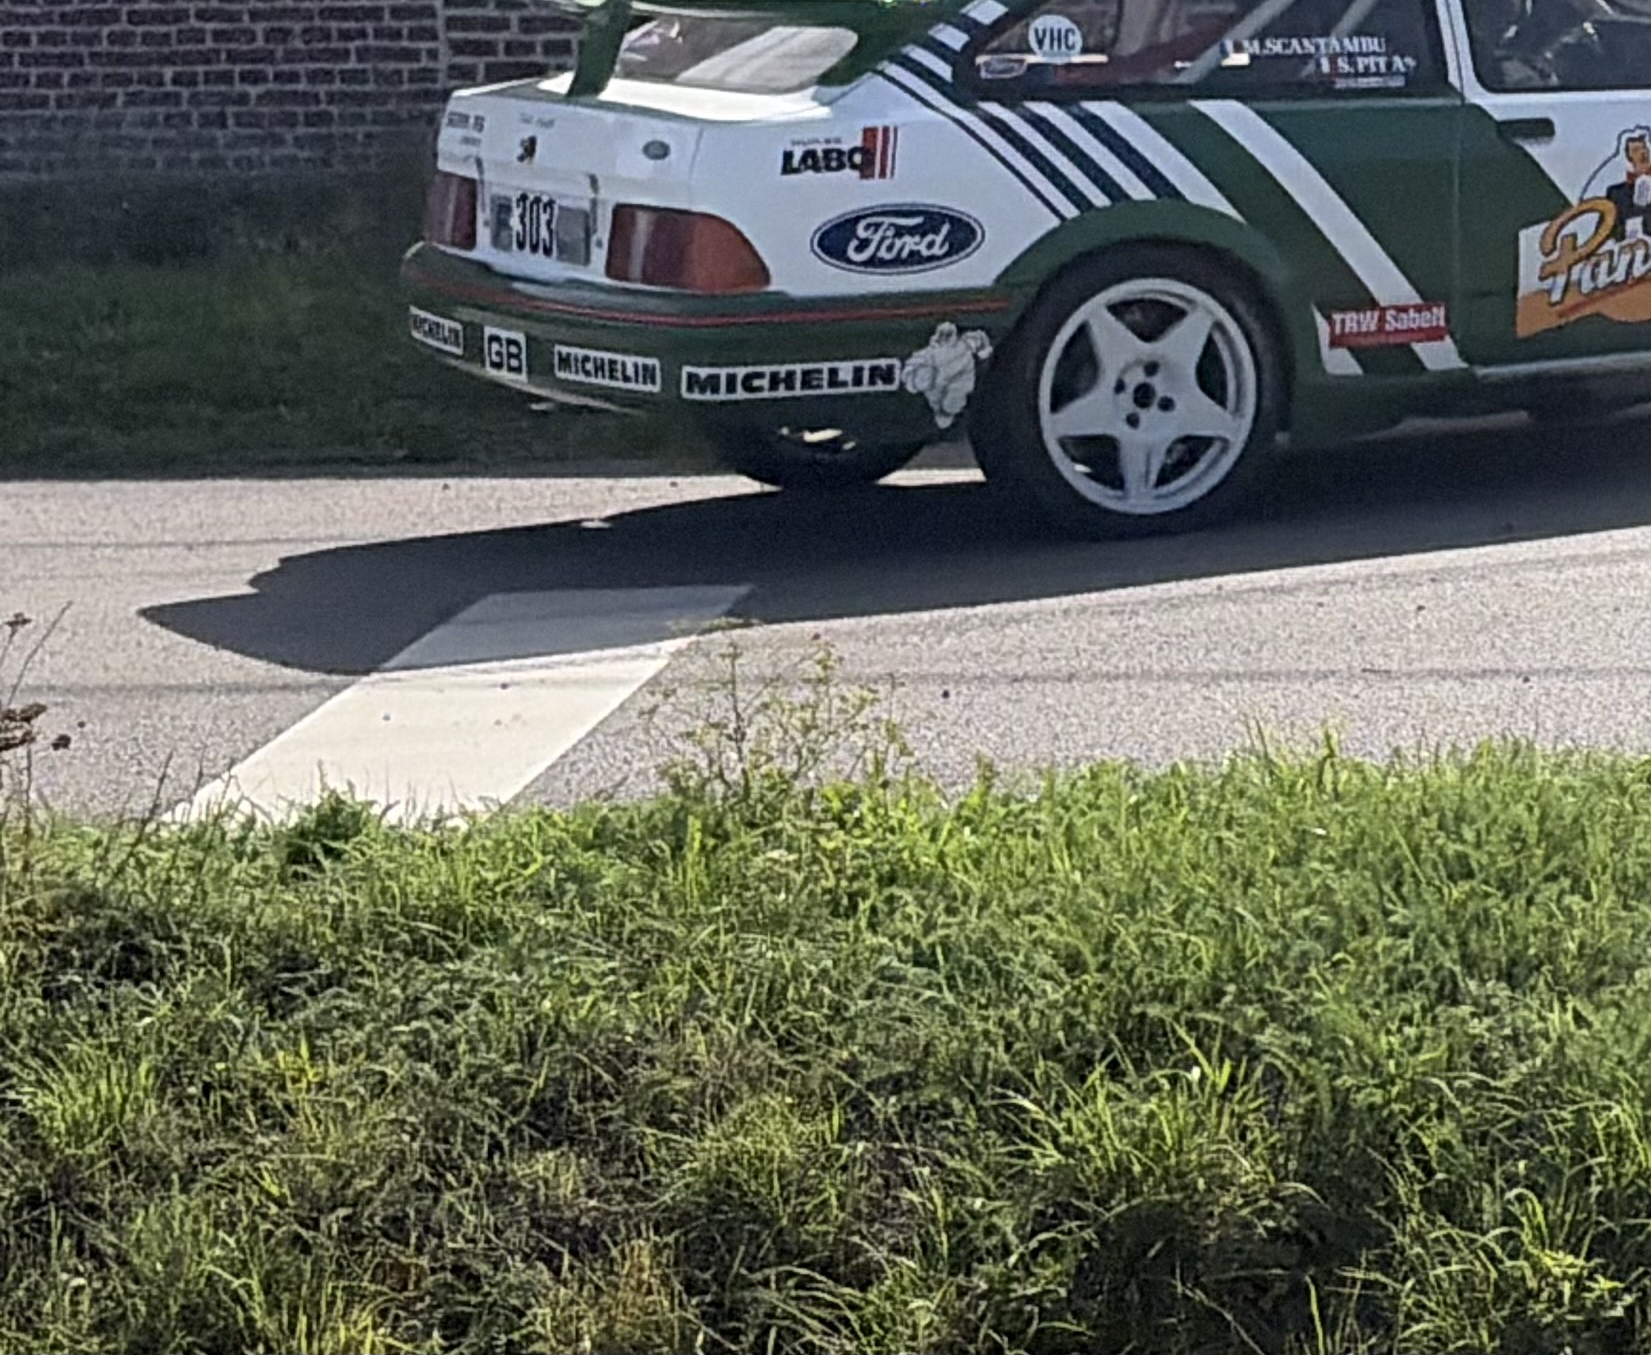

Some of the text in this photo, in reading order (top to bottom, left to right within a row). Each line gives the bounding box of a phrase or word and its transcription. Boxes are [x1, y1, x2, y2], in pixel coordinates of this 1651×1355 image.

[1034, 27, 1076, 50] VHC
[516, 192, 556, 257] 303
[847, 215, 950, 263] Ford
[1330, 309, 1379, 335] TRW
[487, 335, 523, 375] GB
[557, 350, 657, 386] MICHELIN
[686, 363, 896, 395] MICHELIN
